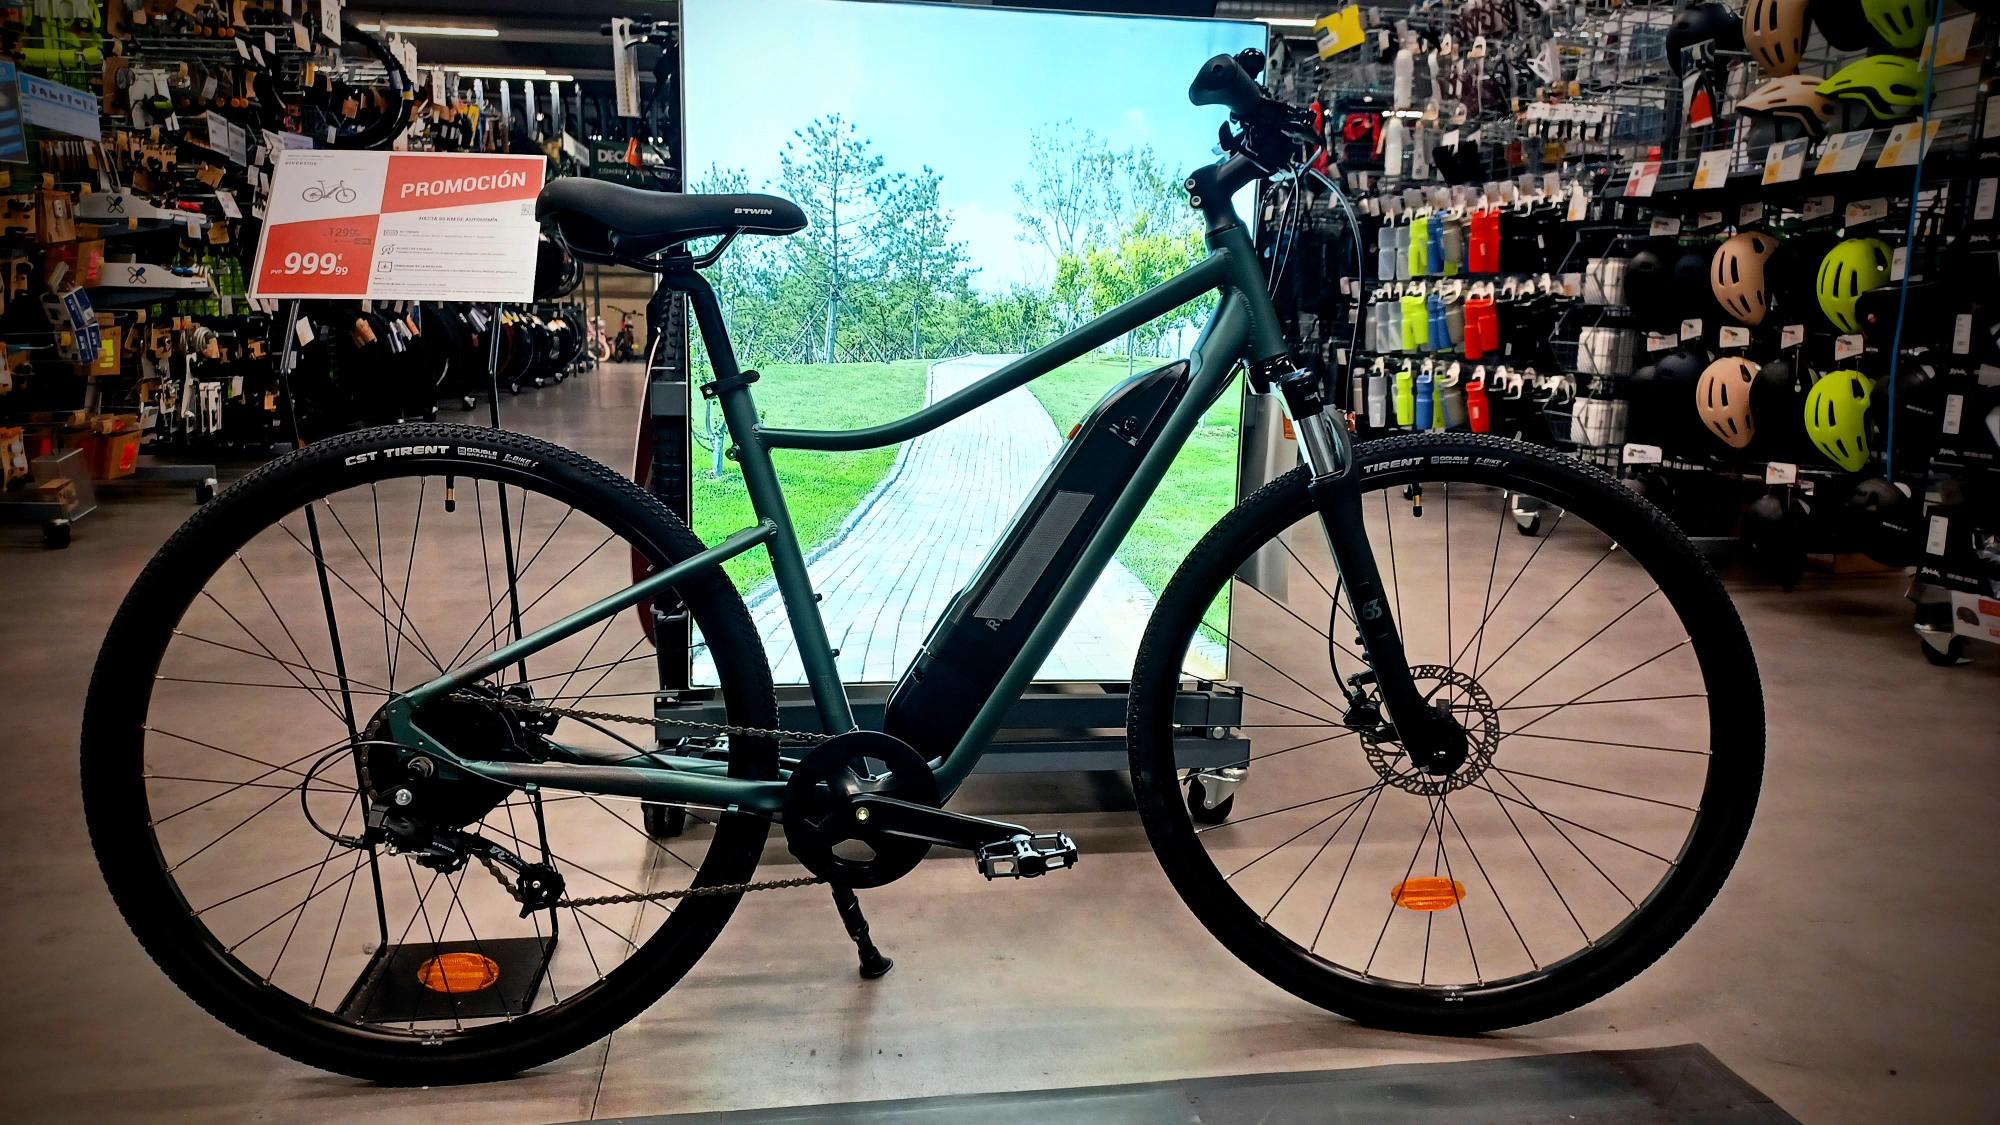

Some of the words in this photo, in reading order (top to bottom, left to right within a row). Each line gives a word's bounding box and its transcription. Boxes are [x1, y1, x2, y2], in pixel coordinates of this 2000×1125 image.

[400, 170, 526, 198] PROMOCIÓN
[345, 451, 378, 466] CST
[383, 445, 450, 458] TIRENT
[467, 447, 498, 457] DOUBLE
[1363, 456, 1424, 473] TIRENT
